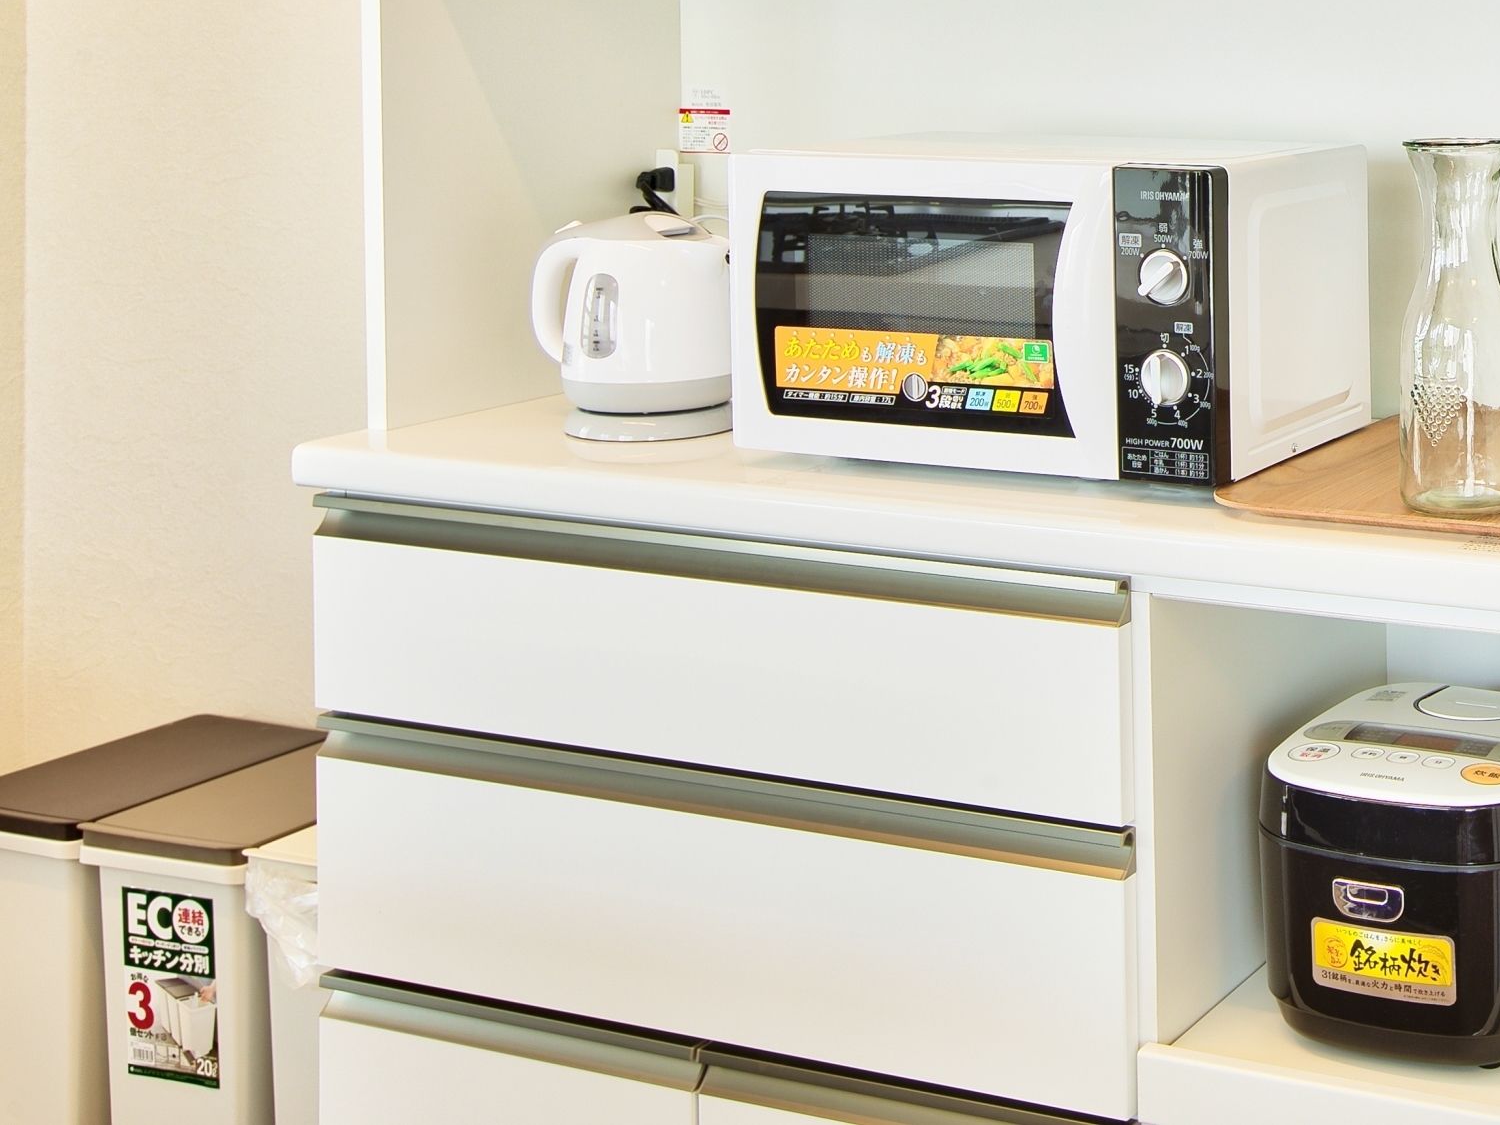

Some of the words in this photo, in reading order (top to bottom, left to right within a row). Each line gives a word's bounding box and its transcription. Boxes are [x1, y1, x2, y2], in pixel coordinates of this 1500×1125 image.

[1140, 191, 1154, 200] IRIS
[1158, 222, 1168, 234] 弱
[1154, 235, 1173, 244] 500W
[1192, 238, 1203, 249] 強
[1120, 247, 1140, 256] 200W
[1188, 251, 1209, 260] 700W
[1160, 332, 1170, 344] 切
[784, 336, 928, 366] あたためも解凍も
[1124, 364, 1135, 374] 15
[1196, 368, 1203, 379] 2
[1127, 389, 1139, 399] 10
[1193, 394, 1200, 404] 3
[1151, 409, 1157, 418] 5
[1174, 410, 1181, 420] 4
[1125, 437, 1143, 446] HIGH
[1144, 438, 1170, 448] POWER
[1170, 437, 1204, 451] 700W
[178, 907, 204, 927] 連結
[129, 945, 210, 975] キッチン分別
[1350, 939, 1441, 982] 銘柄炊き
[127, 981, 155, 1030] 3
